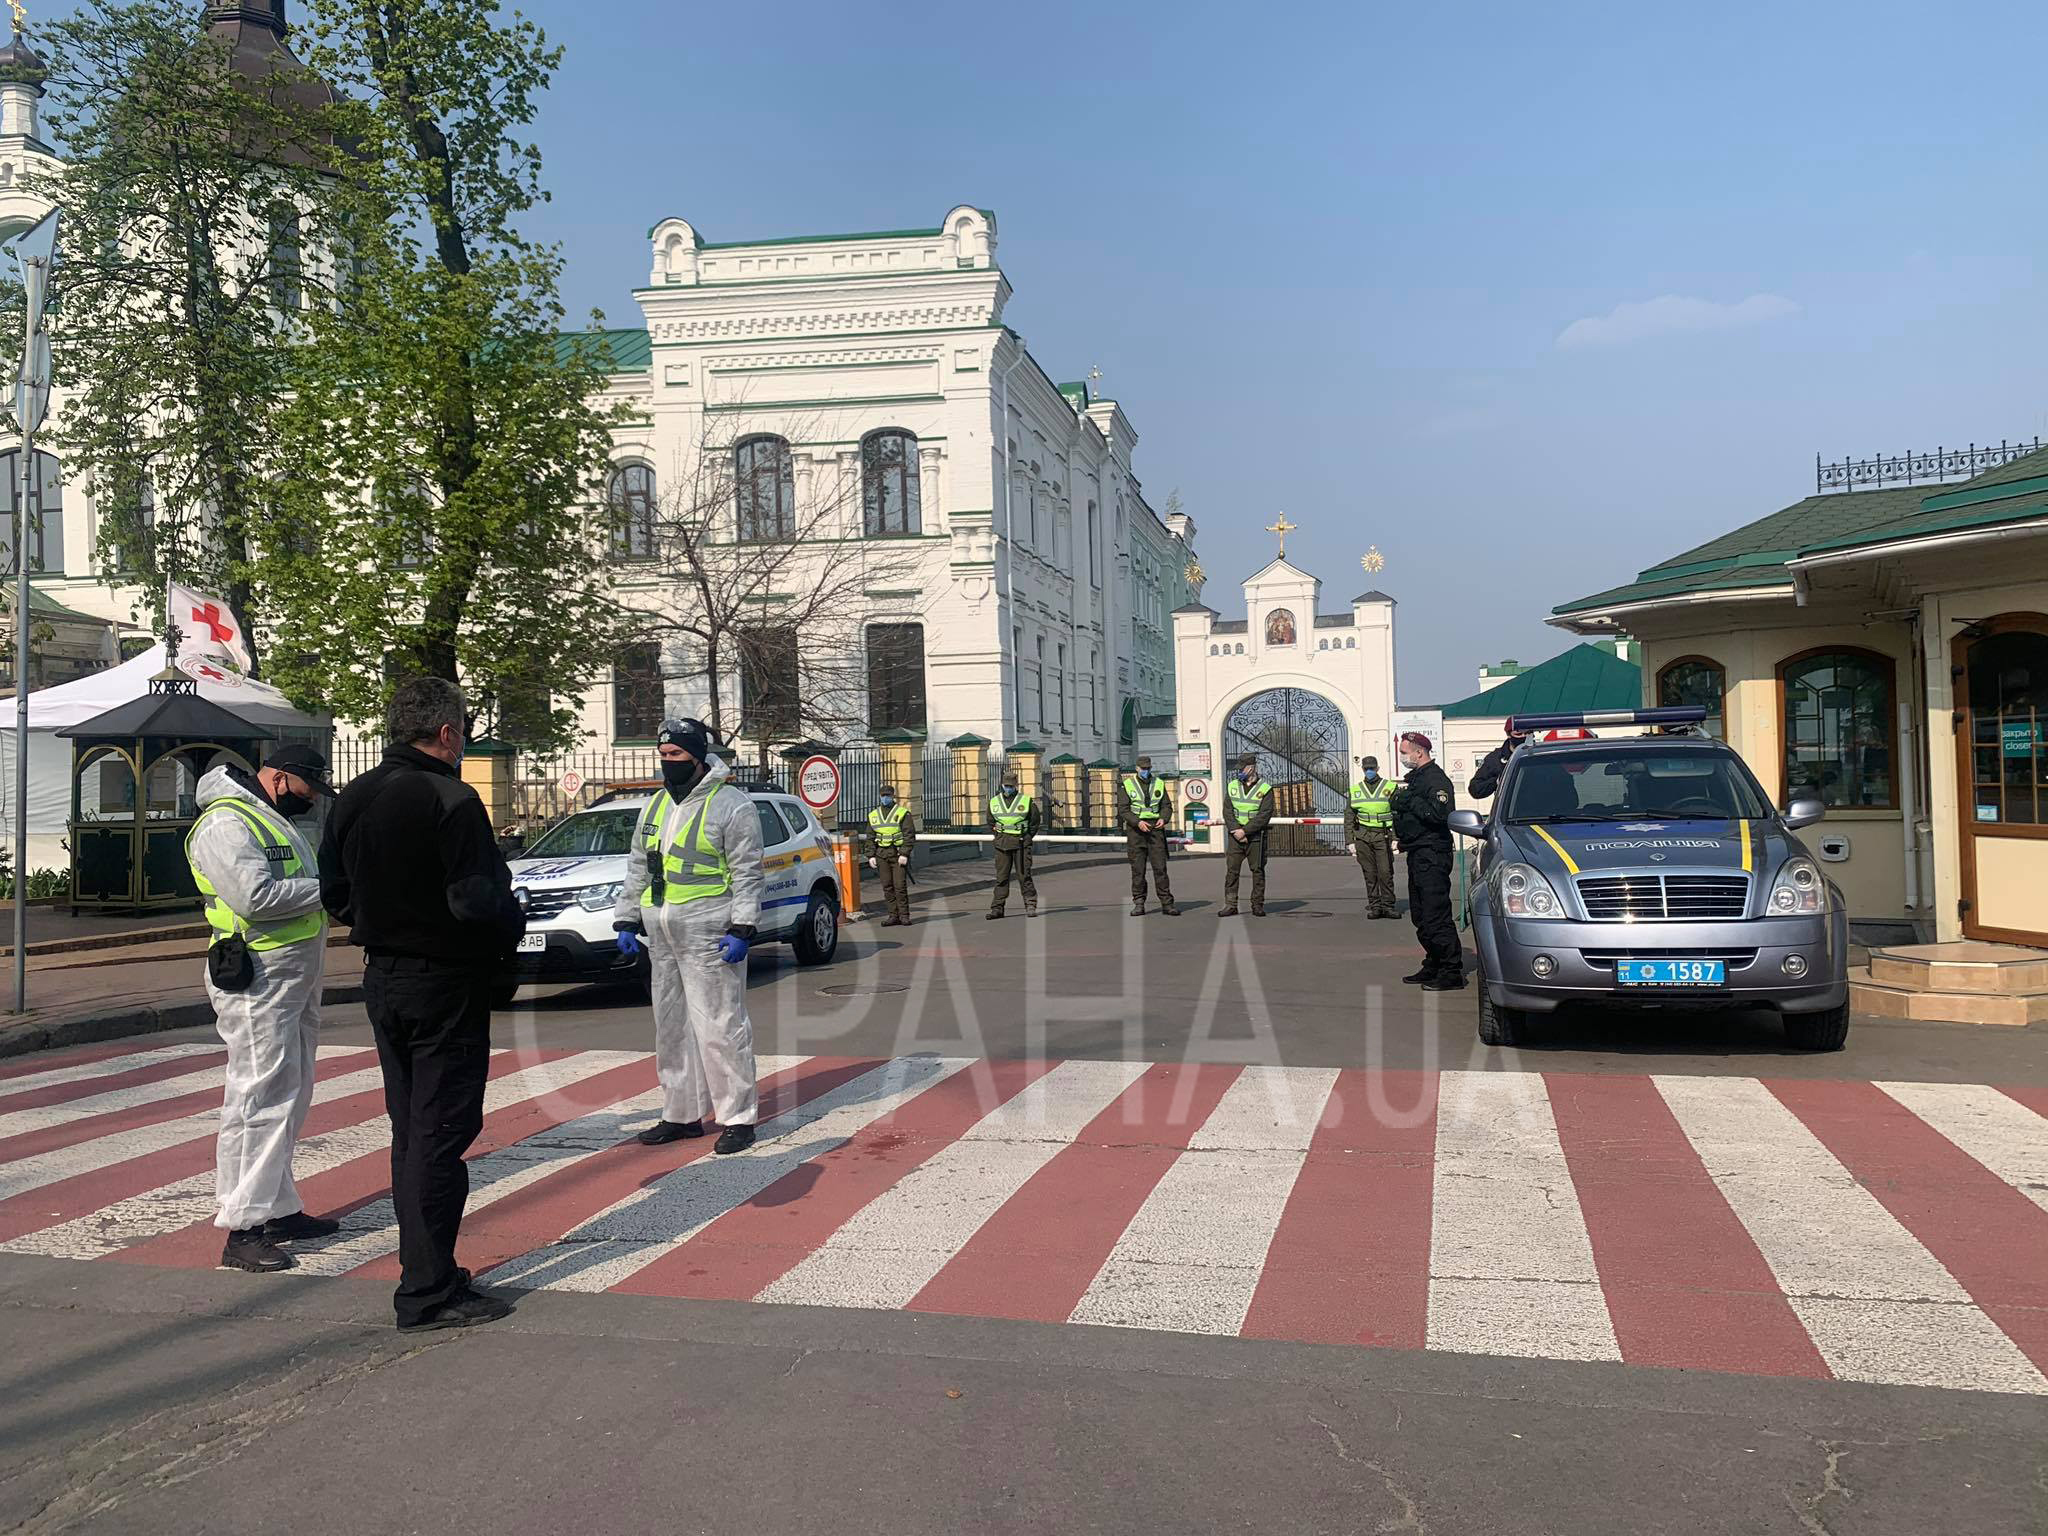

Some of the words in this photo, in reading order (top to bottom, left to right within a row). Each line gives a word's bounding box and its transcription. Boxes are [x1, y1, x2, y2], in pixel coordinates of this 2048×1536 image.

[1190, 785, 1202, 795] 10
[1620, 971, 1630, 980] 11
[1667, 962, 1716, 981] 1587
